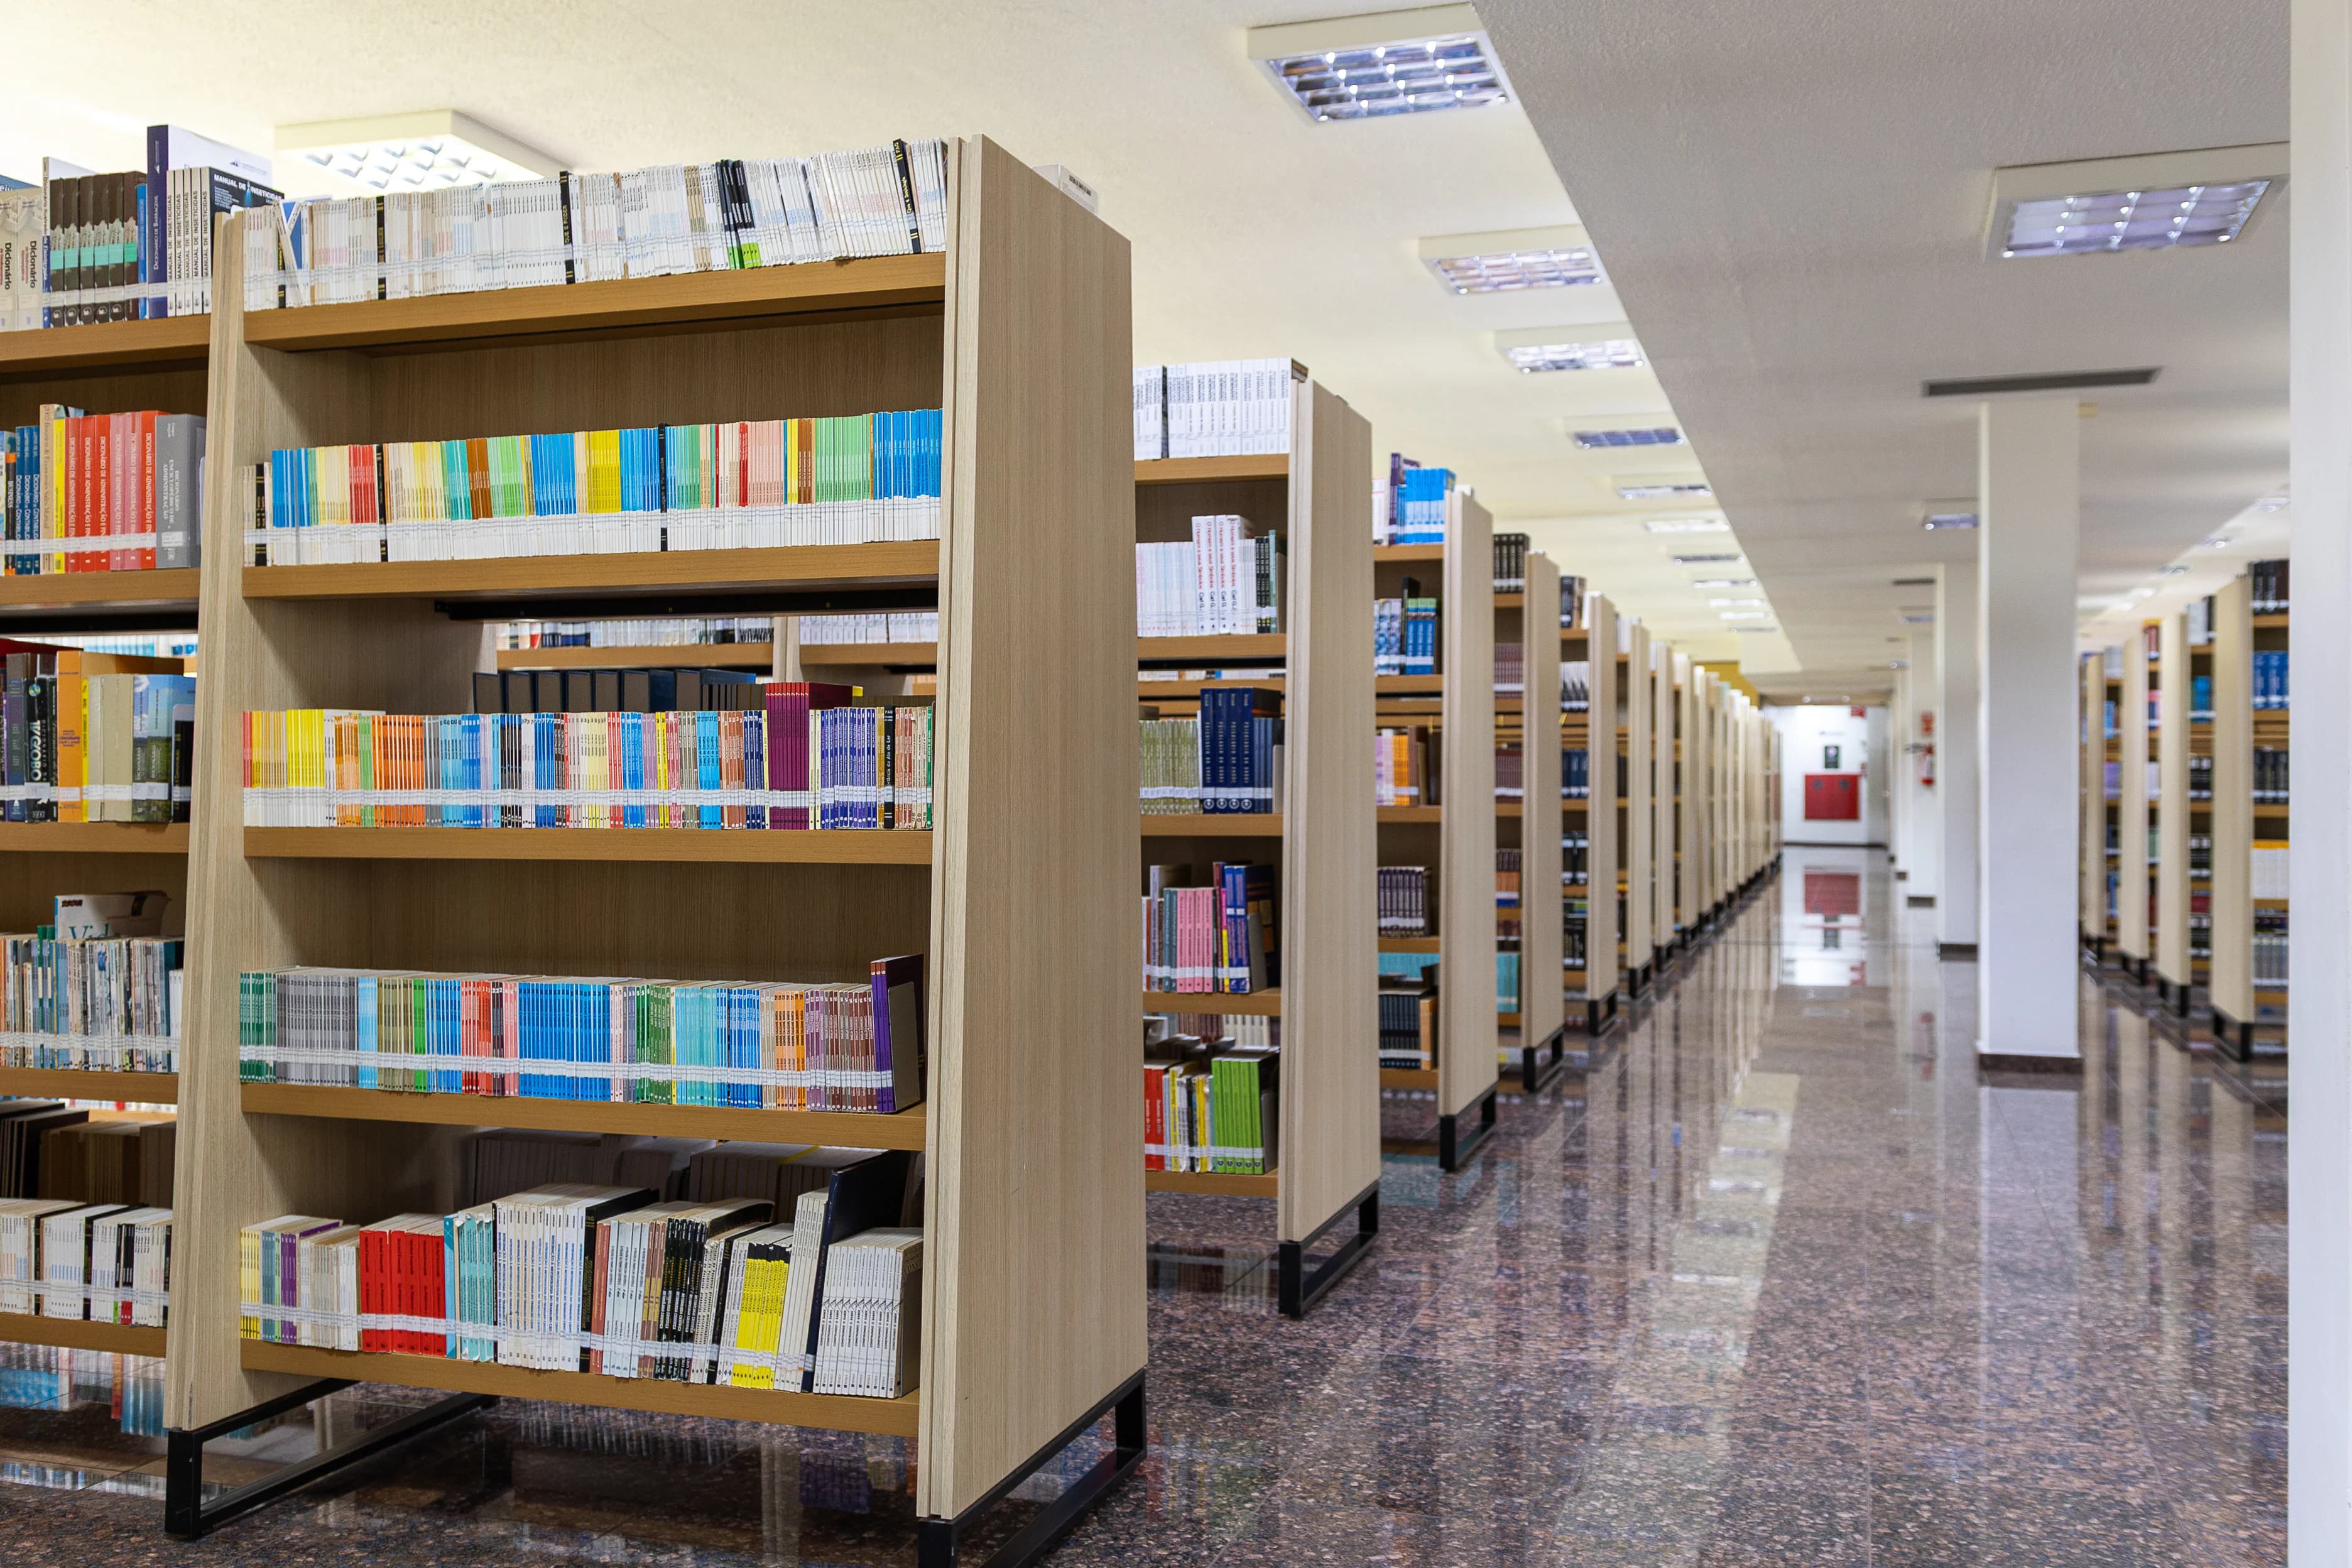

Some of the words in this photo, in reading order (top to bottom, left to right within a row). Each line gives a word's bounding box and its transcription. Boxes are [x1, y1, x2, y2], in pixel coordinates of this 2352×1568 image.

[214, 174, 237, 188] MANUAL
[239, 182, 246, 190] DE
[168, 240, 172, 249] DE
[177, 239, 181, 248] DE
[185, 239, 189, 248] DE
[193, 236, 198, 245] DE
[68, 480, 76, 522] ADMINISTRAÇÃO
[30, 736, 41, 781] GLOBO
